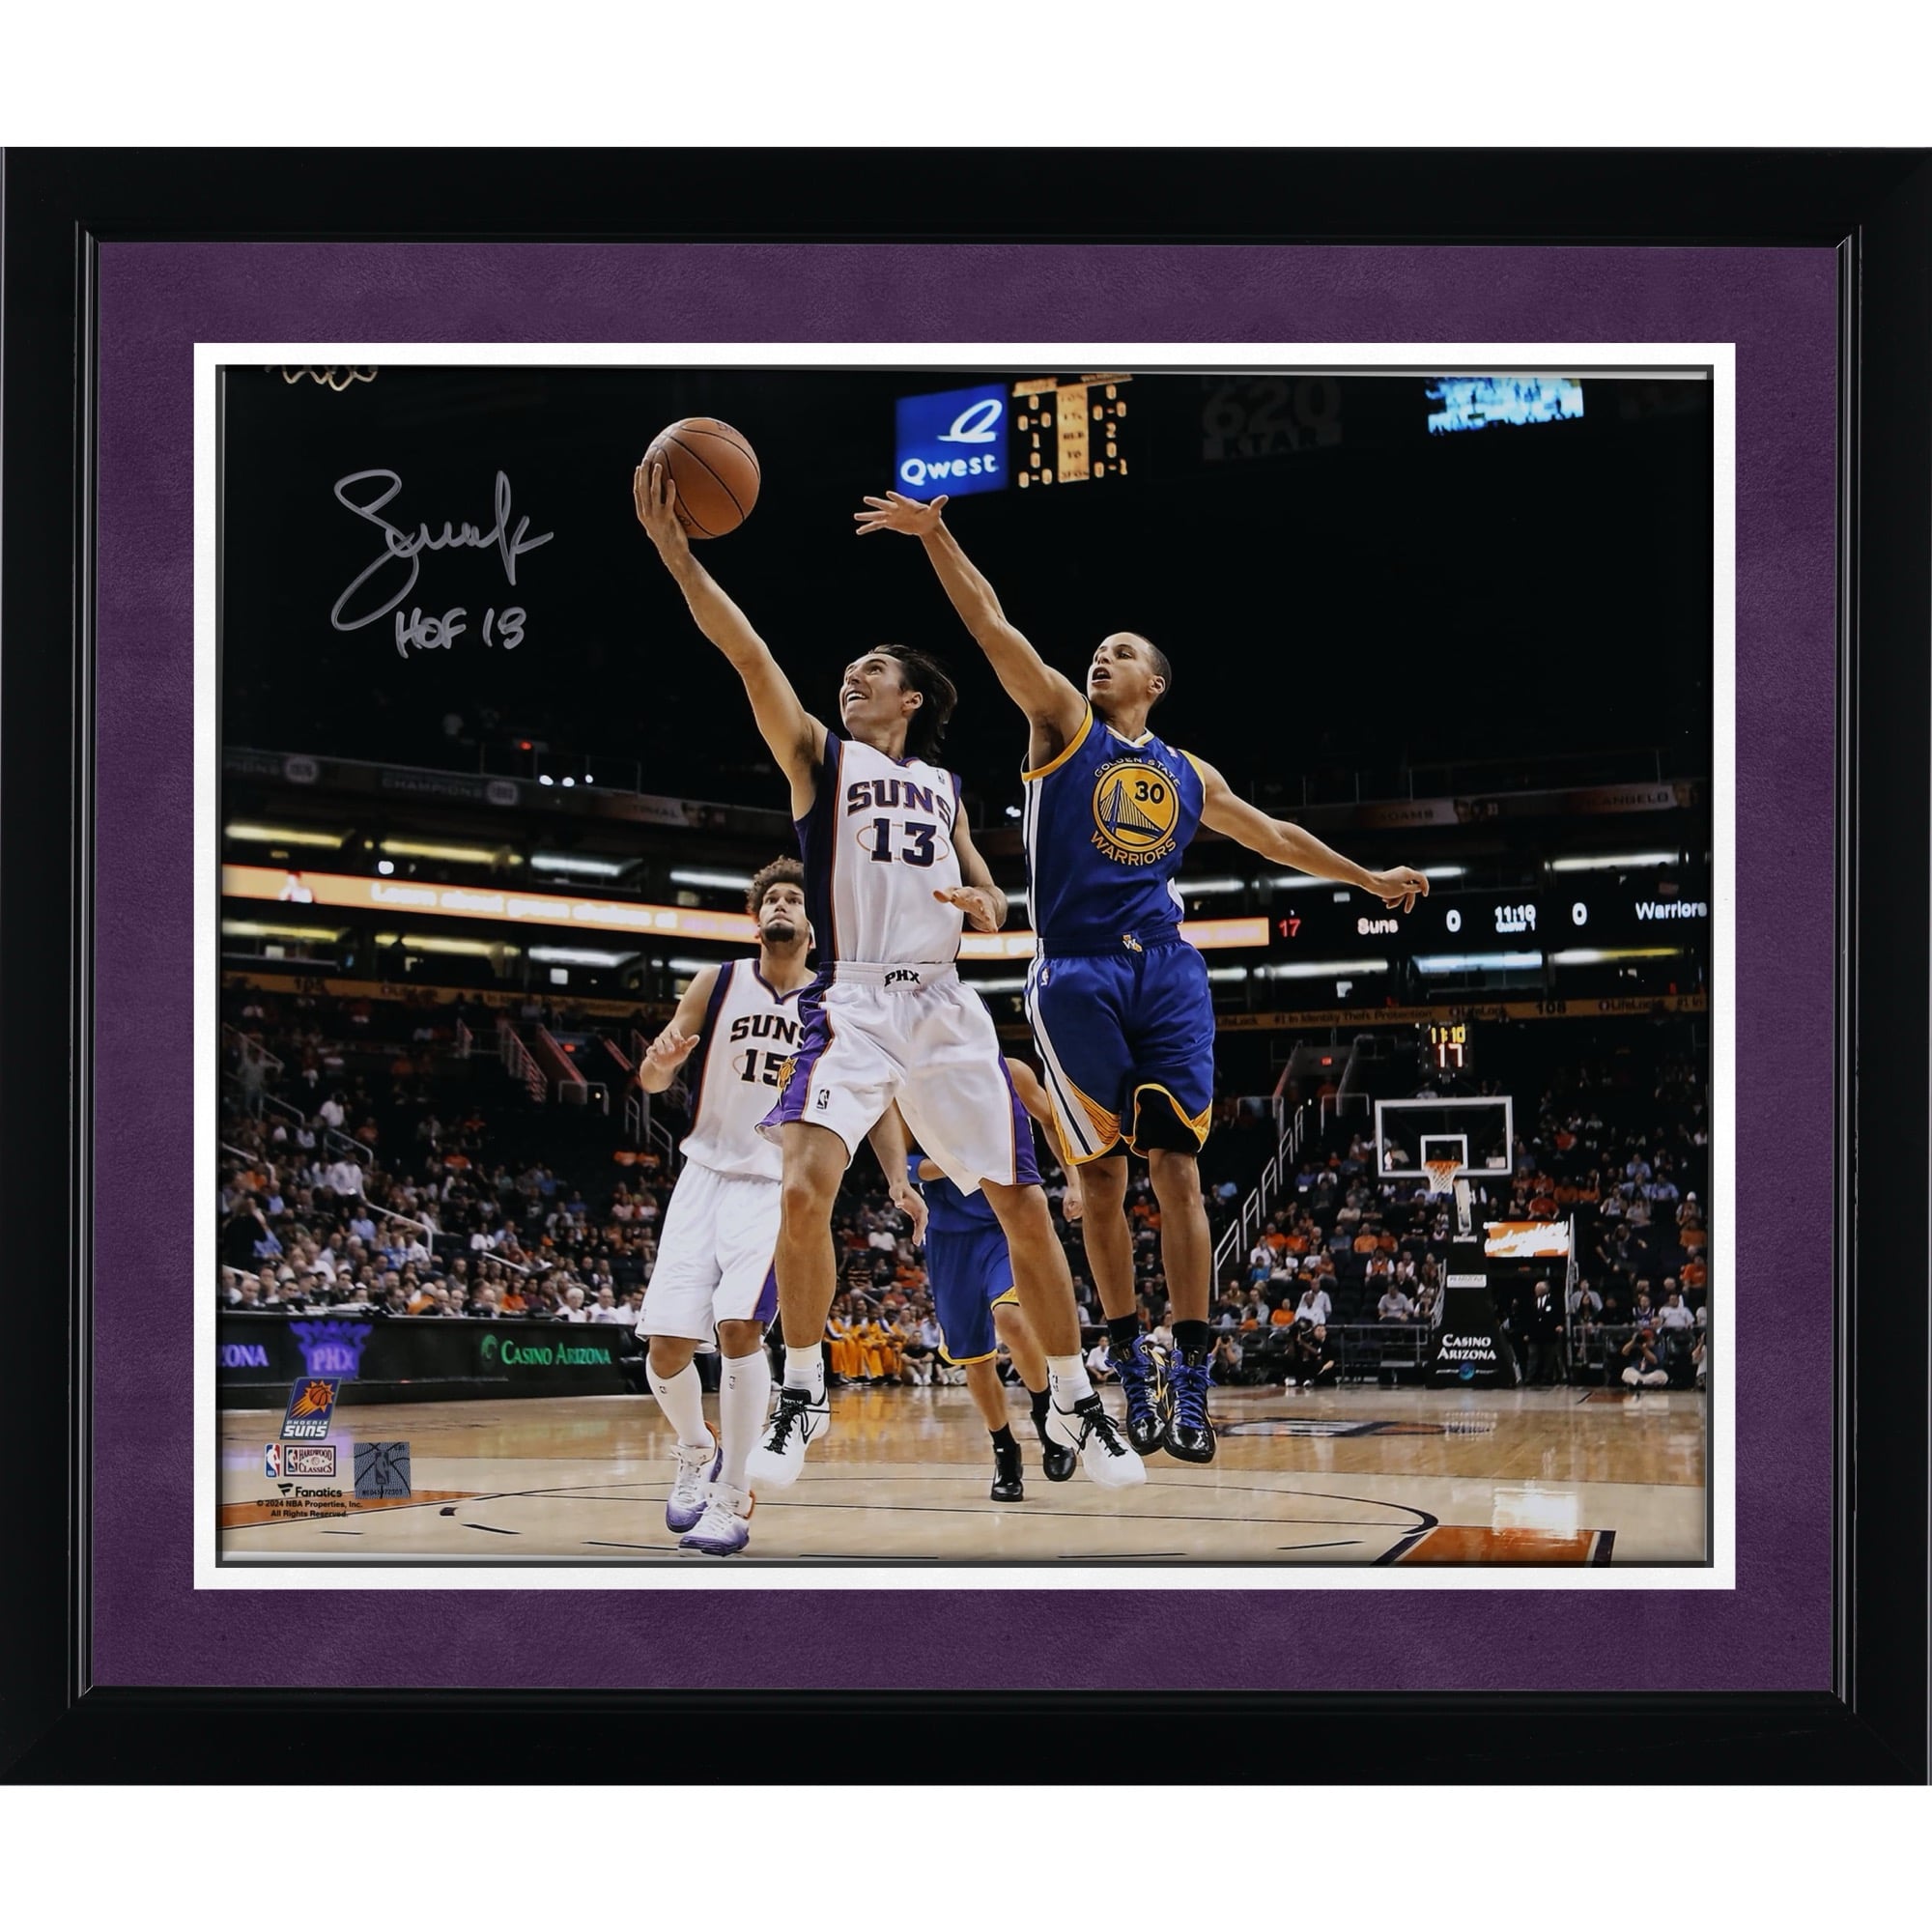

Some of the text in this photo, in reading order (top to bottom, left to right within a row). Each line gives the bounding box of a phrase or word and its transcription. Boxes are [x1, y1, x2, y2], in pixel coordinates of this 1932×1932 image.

[1202, 376, 1342, 440] 620
[1223, 427, 1318, 461] KTAR
[900, 454, 999, 487] Qwest
[395, 607, 527, 659] HOF 18
[1094, 757, 1181, 788] GOLDEN STATE
[847, 779, 952, 830] SUNS
[1134, 780, 1166, 804] 30
[870, 817, 937, 867] 13
[1090, 830, 1177, 867] WARRIORS
[1278, 917, 1301, 938] 17
[1357, 917, 1400, 935] Suns
[1445, 909, 1462, 933] 0
[1571, 901, 1588, 926] 0
[1634, 900, 1708, 921] Warriors
[884, 969, 921, 987] PHX
[1430, 1026, 1466, 1044] 11:10
[742, 1049, 790, 1087] 15
[1436, 1043, 1463, 1067] 17
[500, 1340, 612, 1365] CASINO ARIZONA
[1436, 1347, 1497, 1361] ARIZONA
[1442, 1334, 1492, 1348] CASINO
[312, 1347, 356, 1372] PHX
